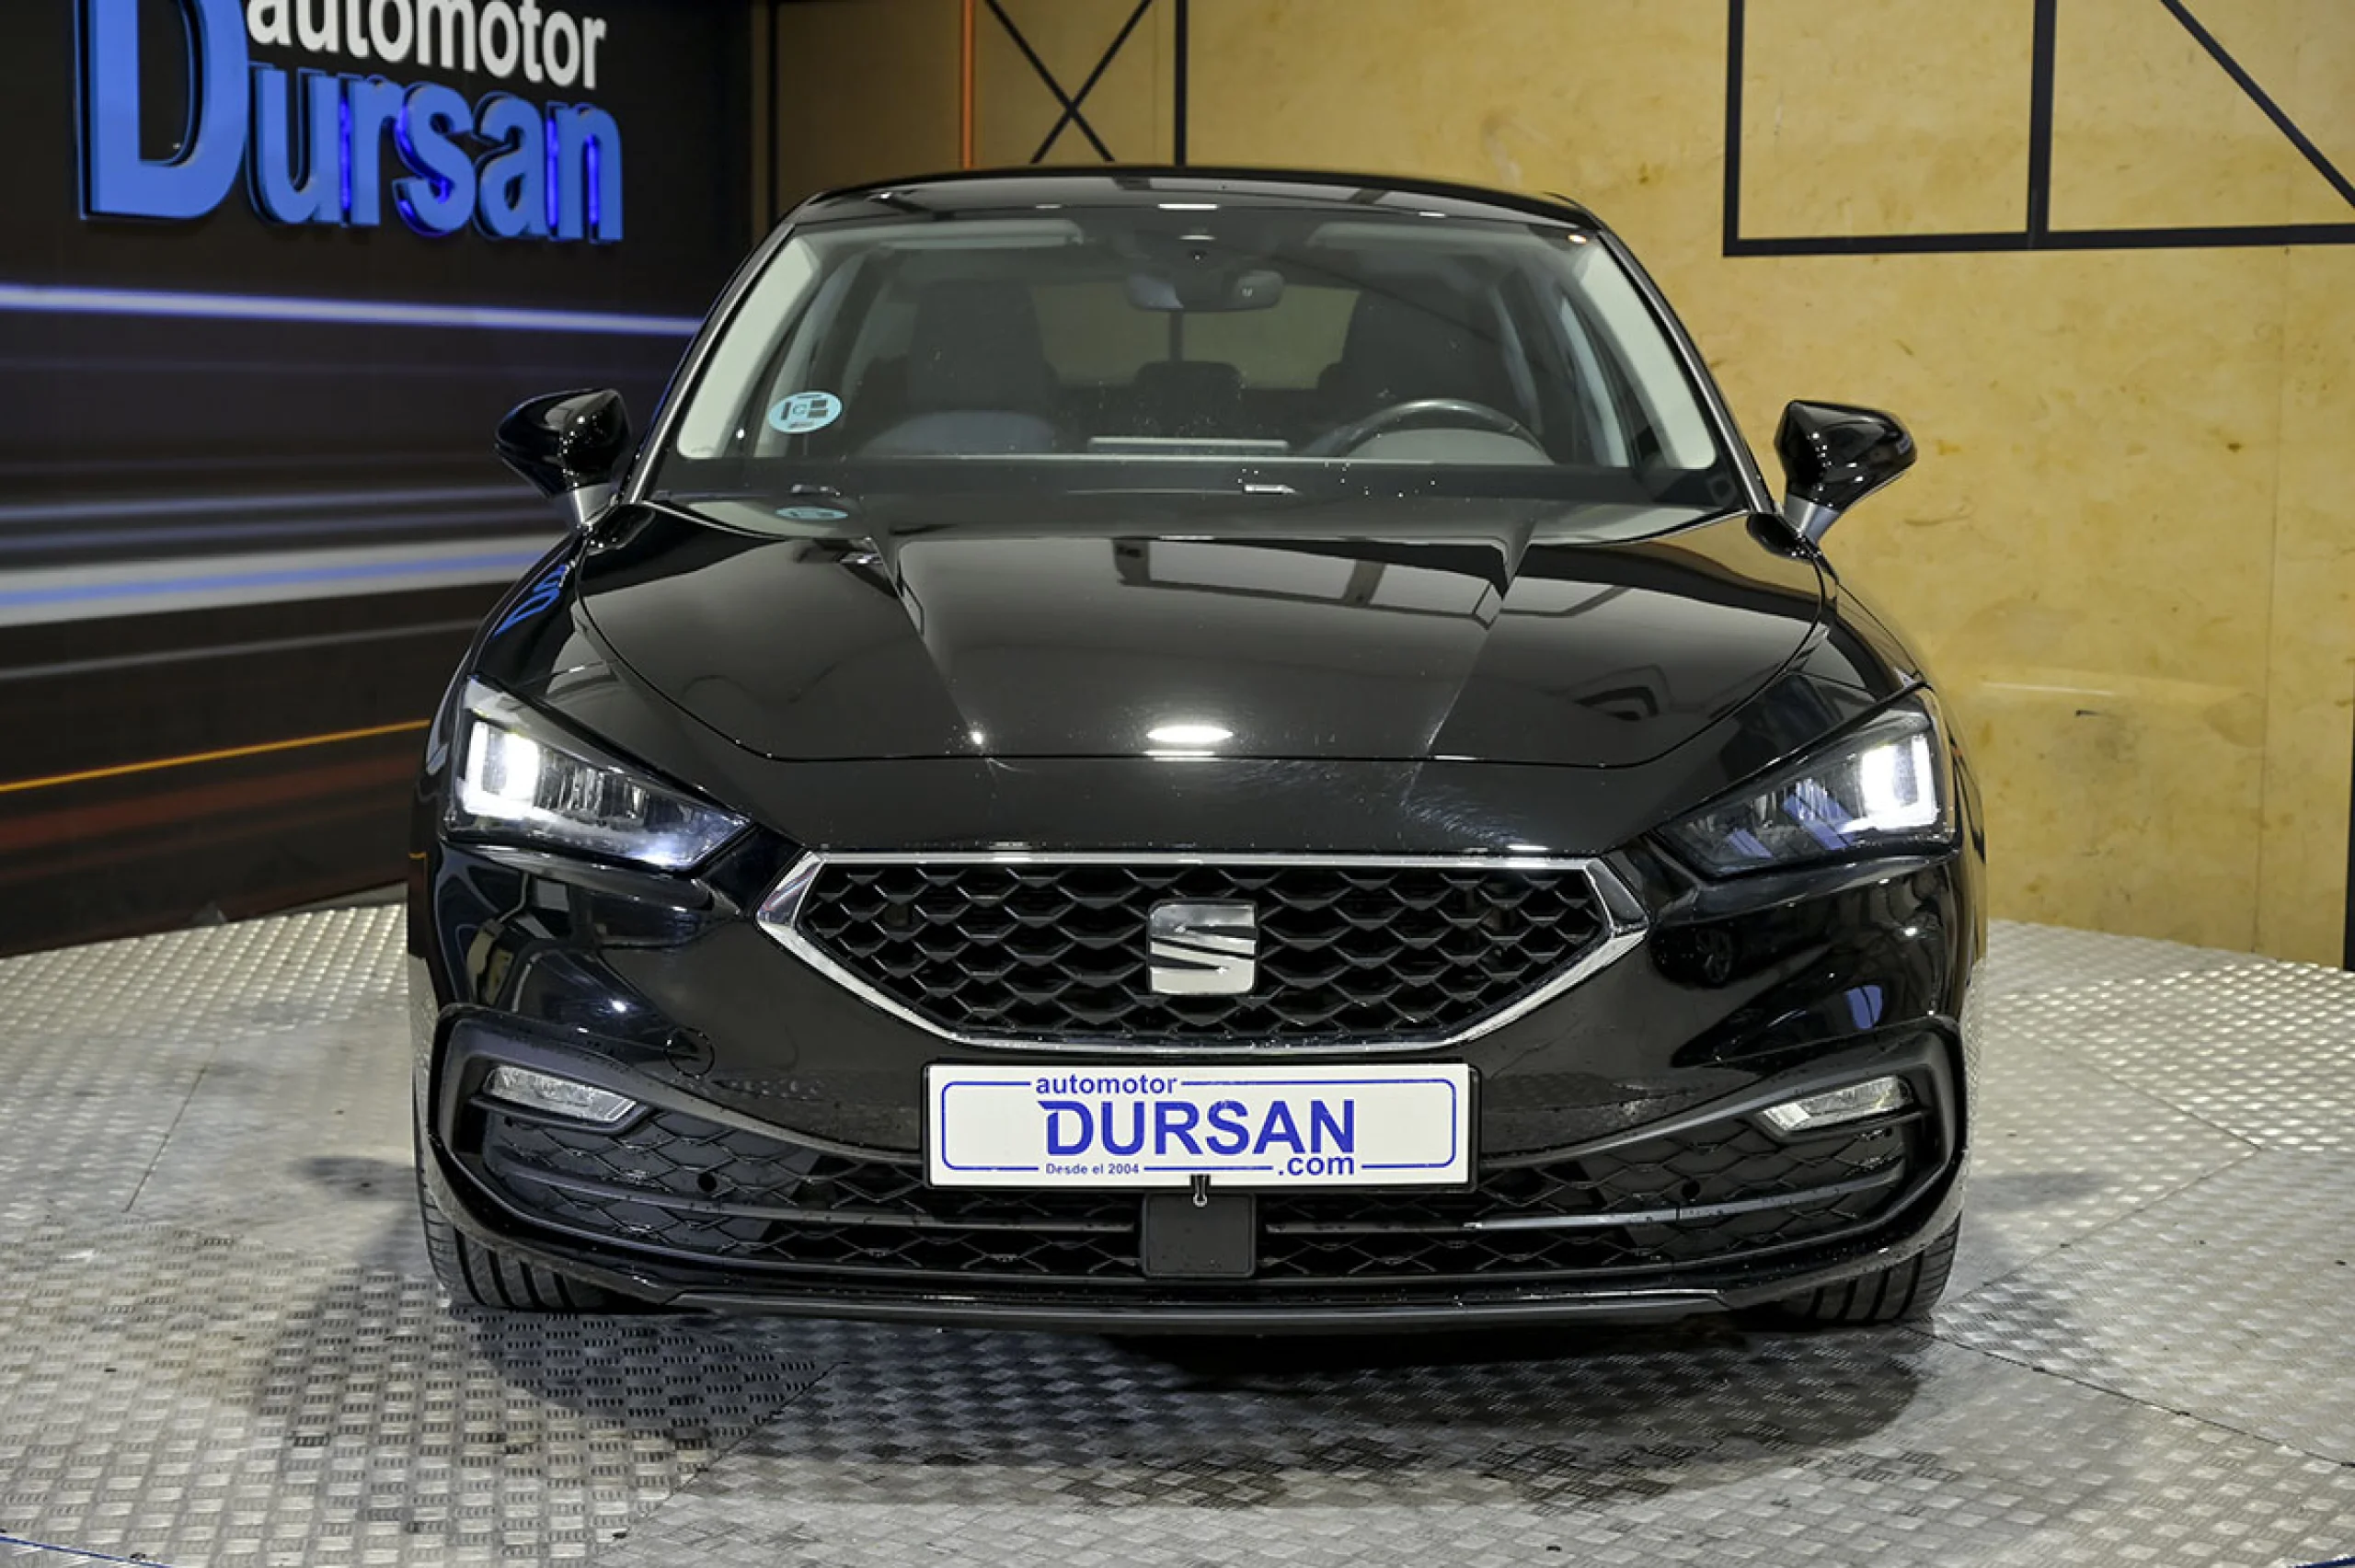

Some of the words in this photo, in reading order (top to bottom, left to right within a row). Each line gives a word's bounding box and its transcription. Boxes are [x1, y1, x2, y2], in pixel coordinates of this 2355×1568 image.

[247, 0, 606, 89] automotor
[79, 0, 623, 244] Dursan
[1036, 1073, 1178, 1095] automotor
[1038, 1100, 1355, 1156] DURSAN
[1045, 1162, 1088, 1175] Desde
[1092, 1162, 1104, 1175] el
[1108, 1162, 1140, 1175] 2004
[1278, 1156, 1355, 1177] .com
